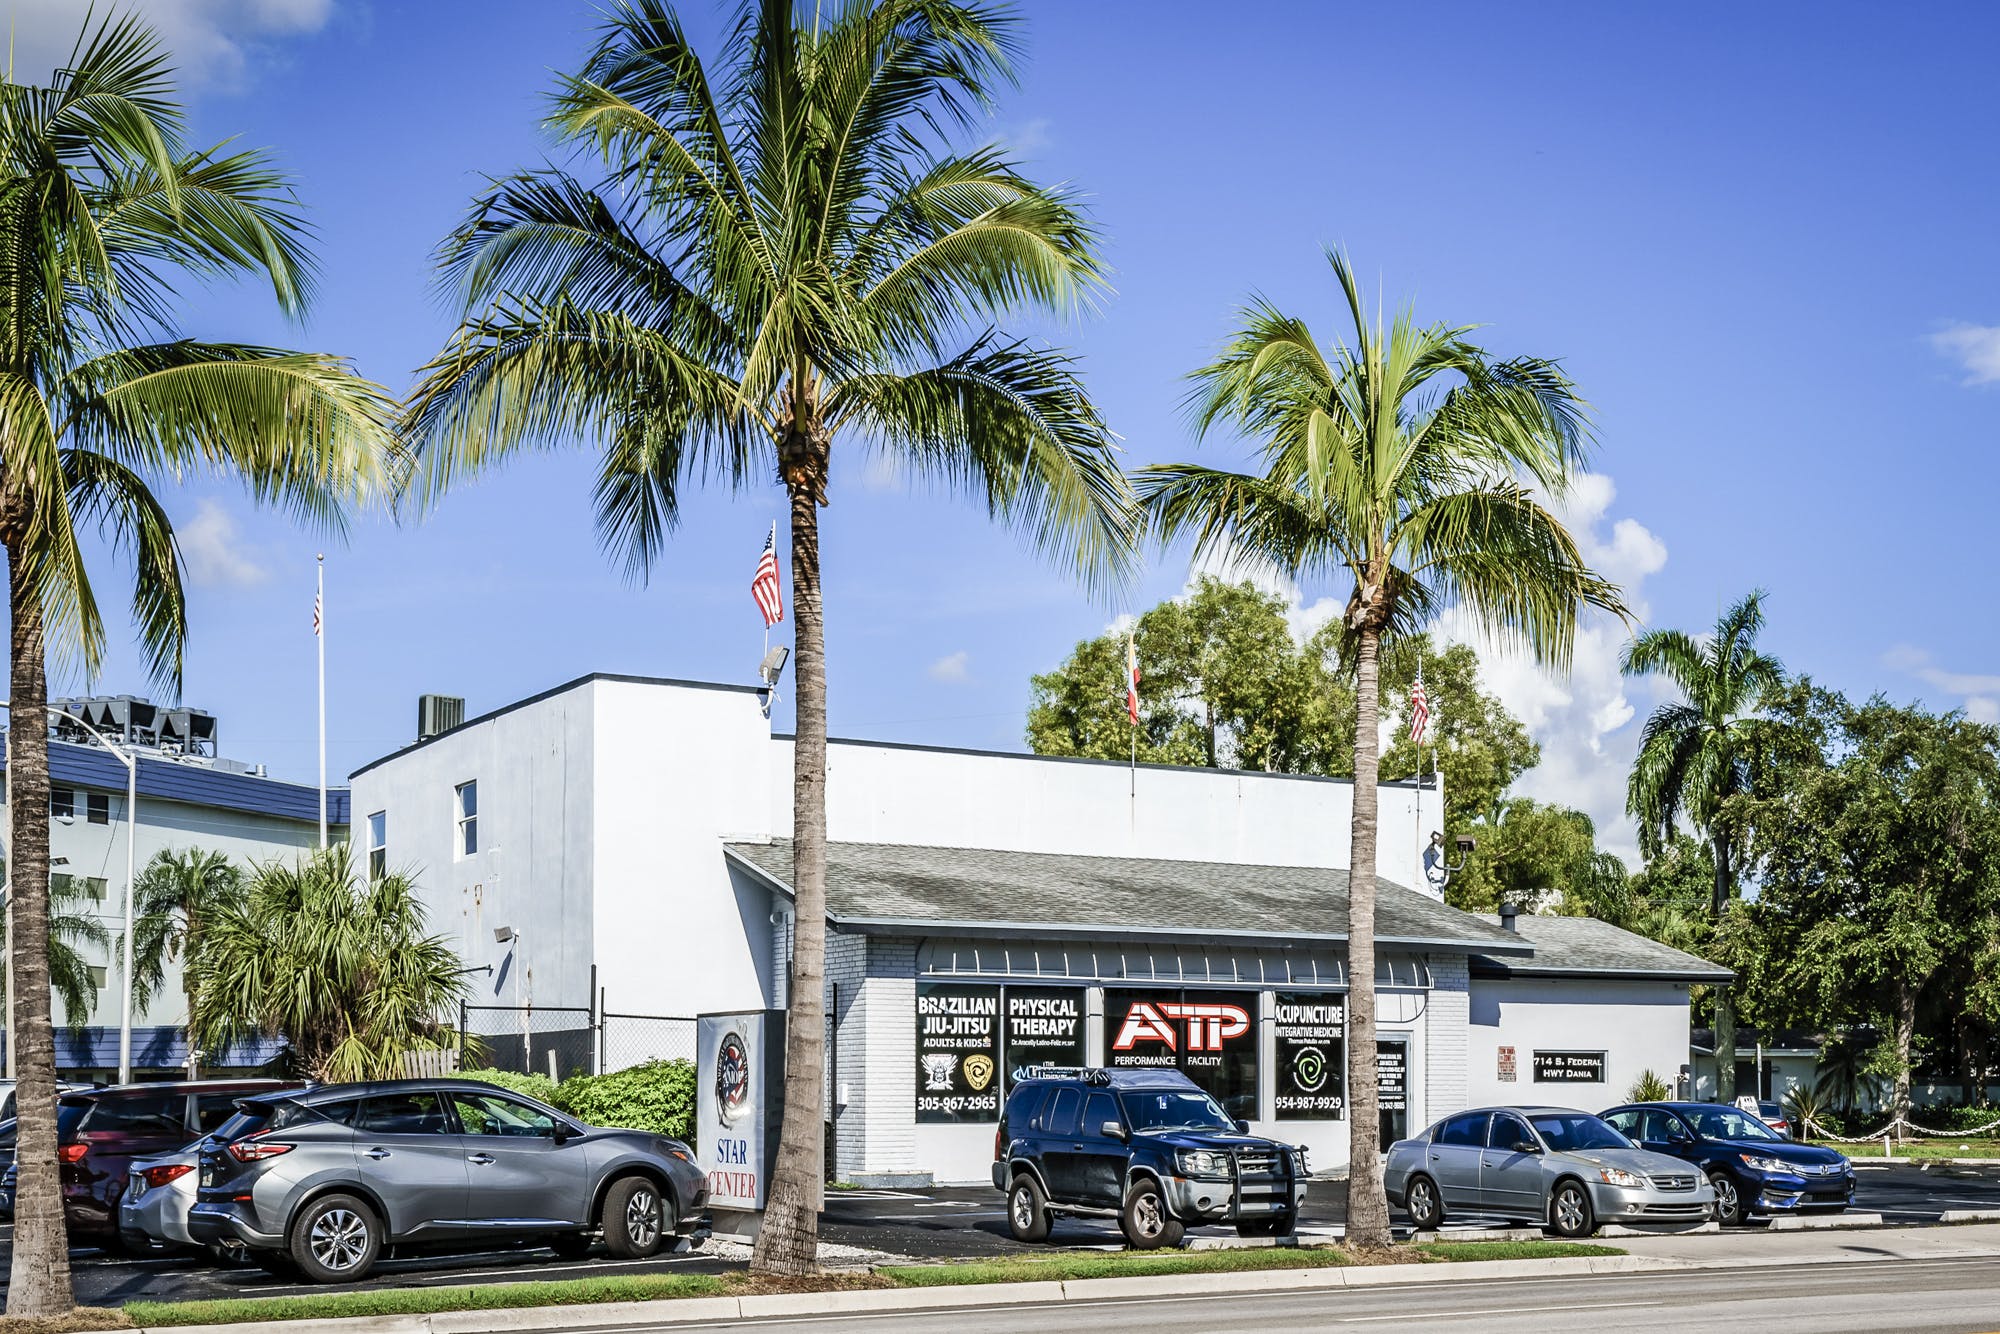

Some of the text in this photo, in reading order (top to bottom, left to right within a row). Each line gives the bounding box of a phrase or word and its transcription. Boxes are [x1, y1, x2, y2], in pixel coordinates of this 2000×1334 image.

[918, 997, 996, 1015] BRAZILIAN
[1009, 998, 1079, 1017] PHYSICAL
[1275, 1005, 1343, 1024] ACUPUNCTURE
[923, 1017, 991, 1035] JIU-JITSU
[1011, 1018, 1077, 1036] THERAPY
[1112, 1002, 1250, 1052] ATP
[1275, 1026, 1342, 1038] INTEGRATIVE MEDICINE
[924, 1038, 983, 1048] ADULTS & KIDS
[1114, 1056, 1222, 1066] PERFORMANCE FACILITY
[1533, 1057, 1602, 1066] 714 S. FEDERAL
[1543, 1069, 1592, 1078] HWY DANIA
[918, 1096, 996, 1110] 305-967-2965
[1276, 1096, 1342, 1109] 954-987-9929
[717, 1138, 747, 1165] STAR
[708, 1170, 756, 1199] CENTER
